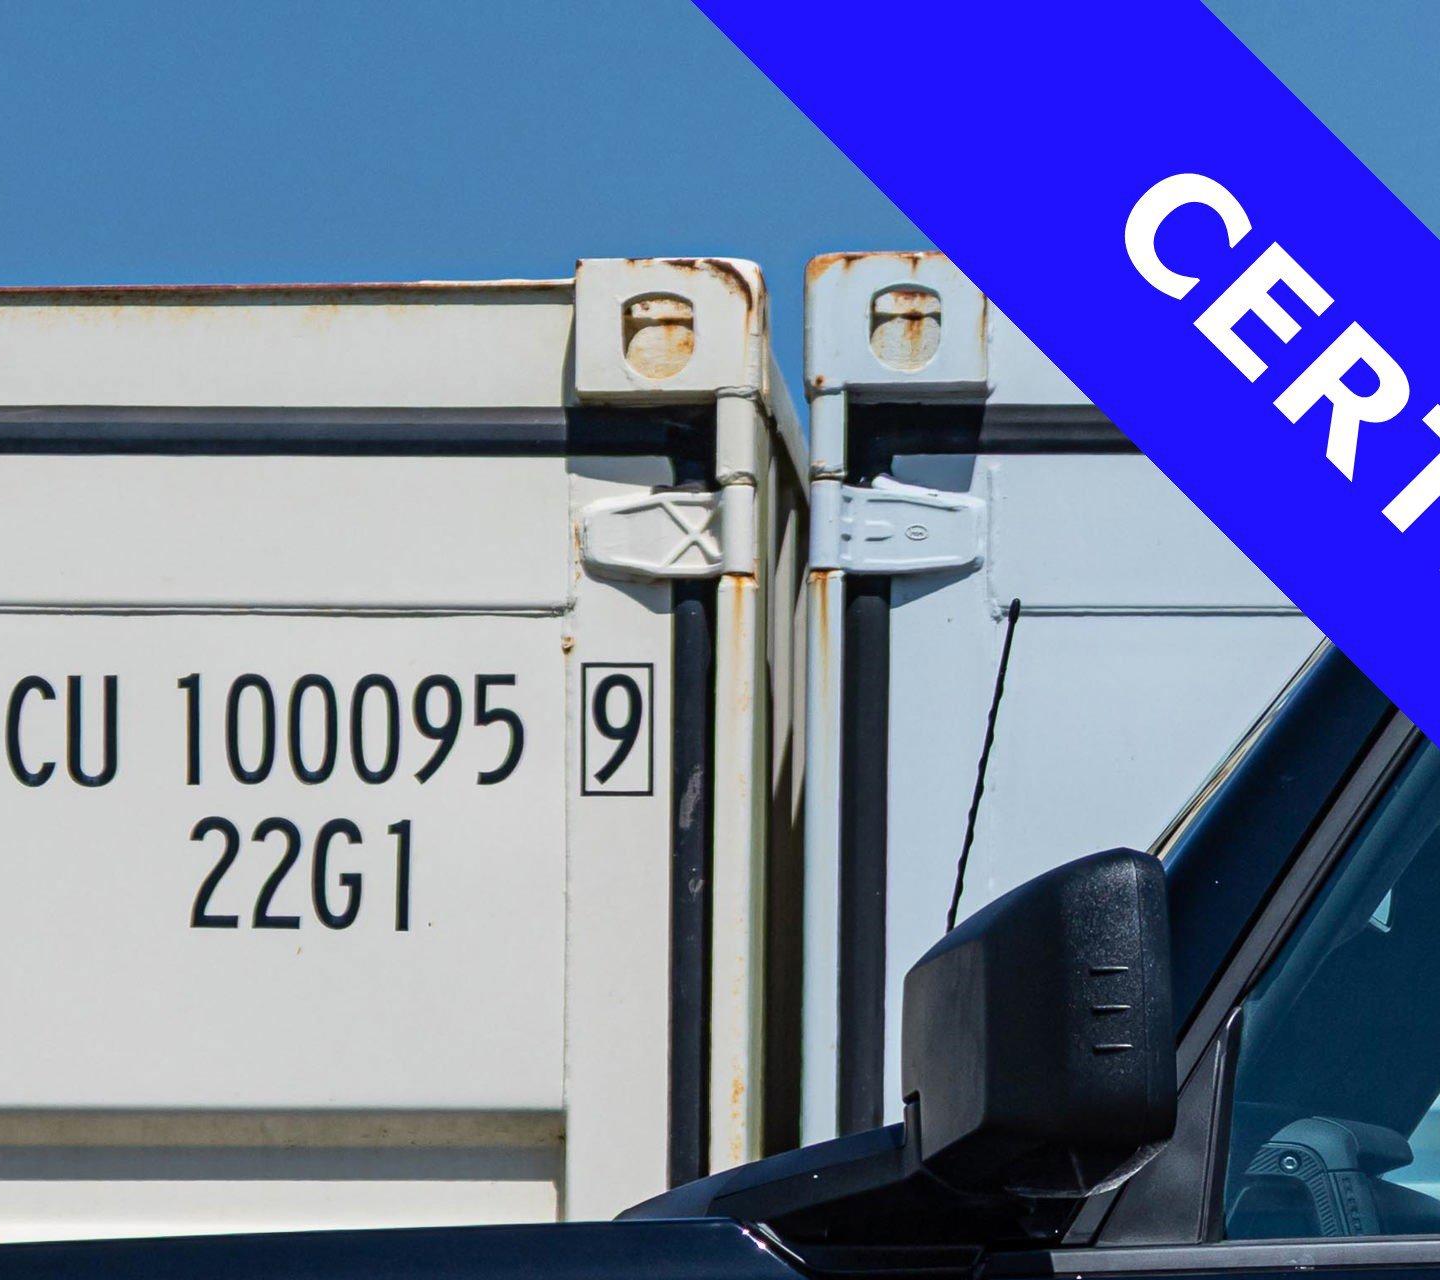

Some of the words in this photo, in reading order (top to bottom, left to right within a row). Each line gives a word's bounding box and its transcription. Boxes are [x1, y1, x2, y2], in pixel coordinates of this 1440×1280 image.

[178, 673, 525, 786] 100095
[592, 673, 643, 785] 9
[190, 816, 411, 932] 22G1
